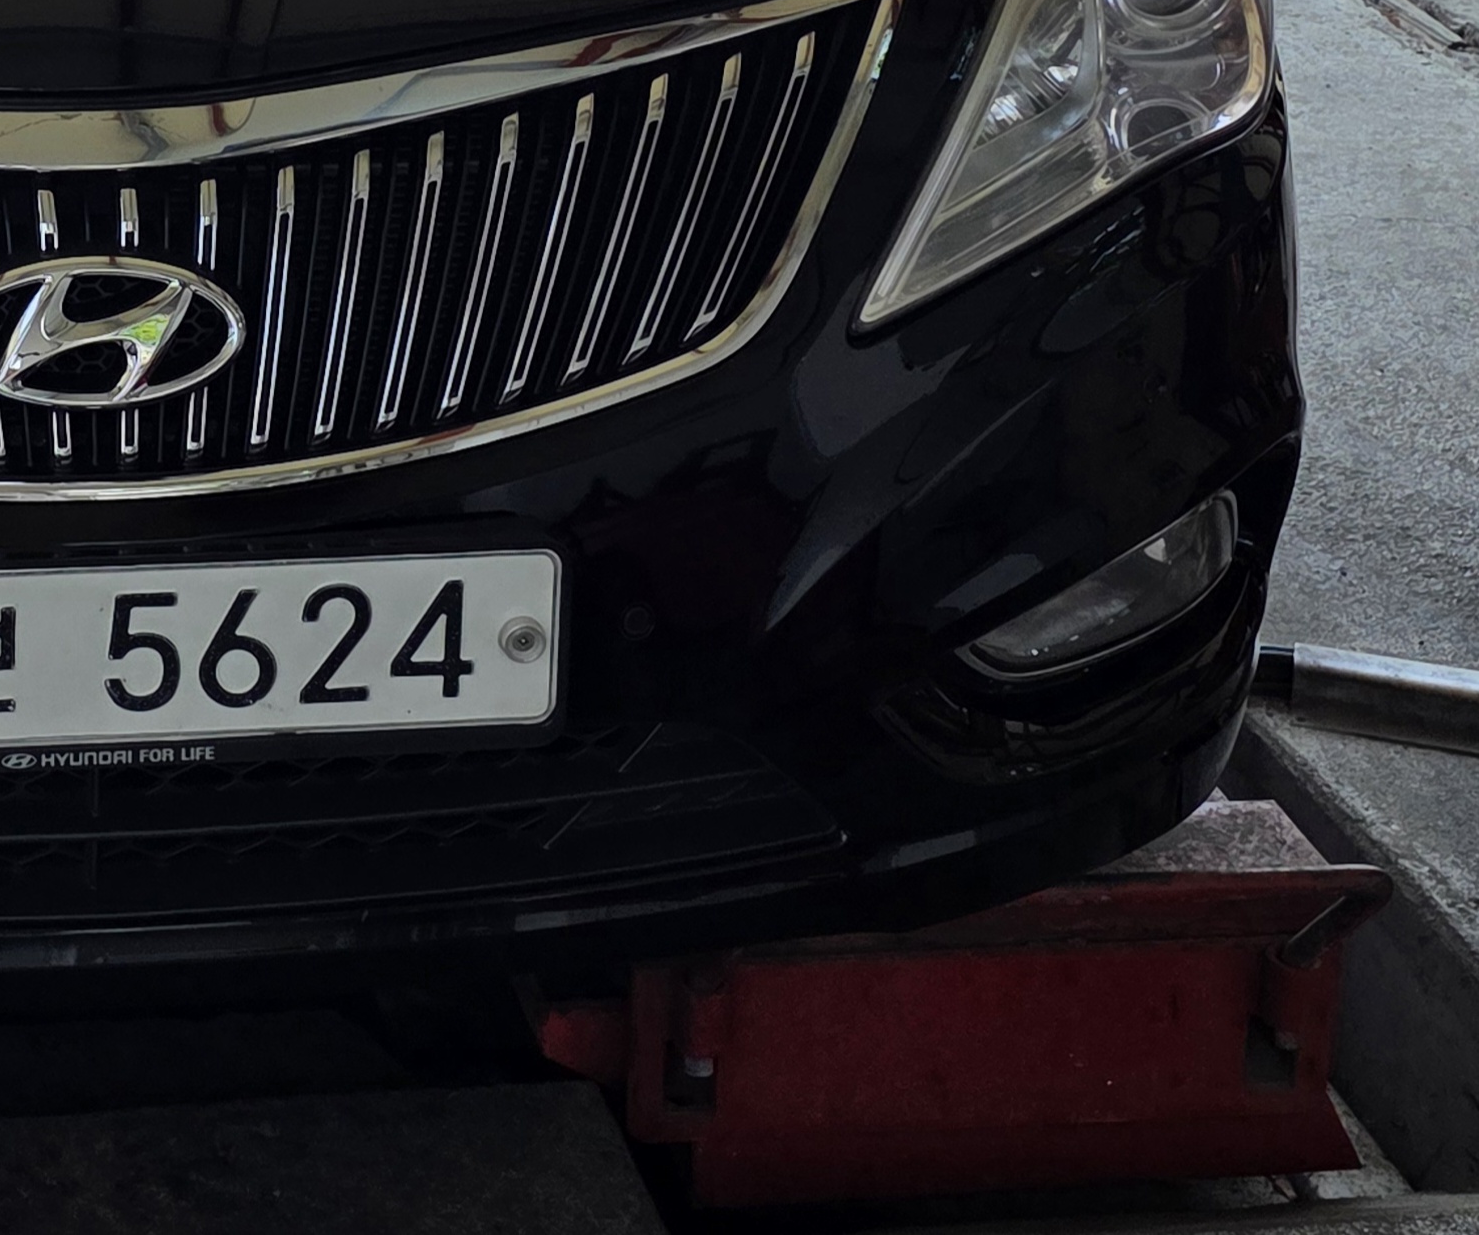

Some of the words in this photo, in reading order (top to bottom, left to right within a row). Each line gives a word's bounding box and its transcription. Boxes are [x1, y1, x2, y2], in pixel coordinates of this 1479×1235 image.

[104, 579, 475, 712] 5624
[41, 749, 133, 767] HYUNDAI
[139, 748, 174, 763] FOR
[181, 746, 216, 761] LIFE
